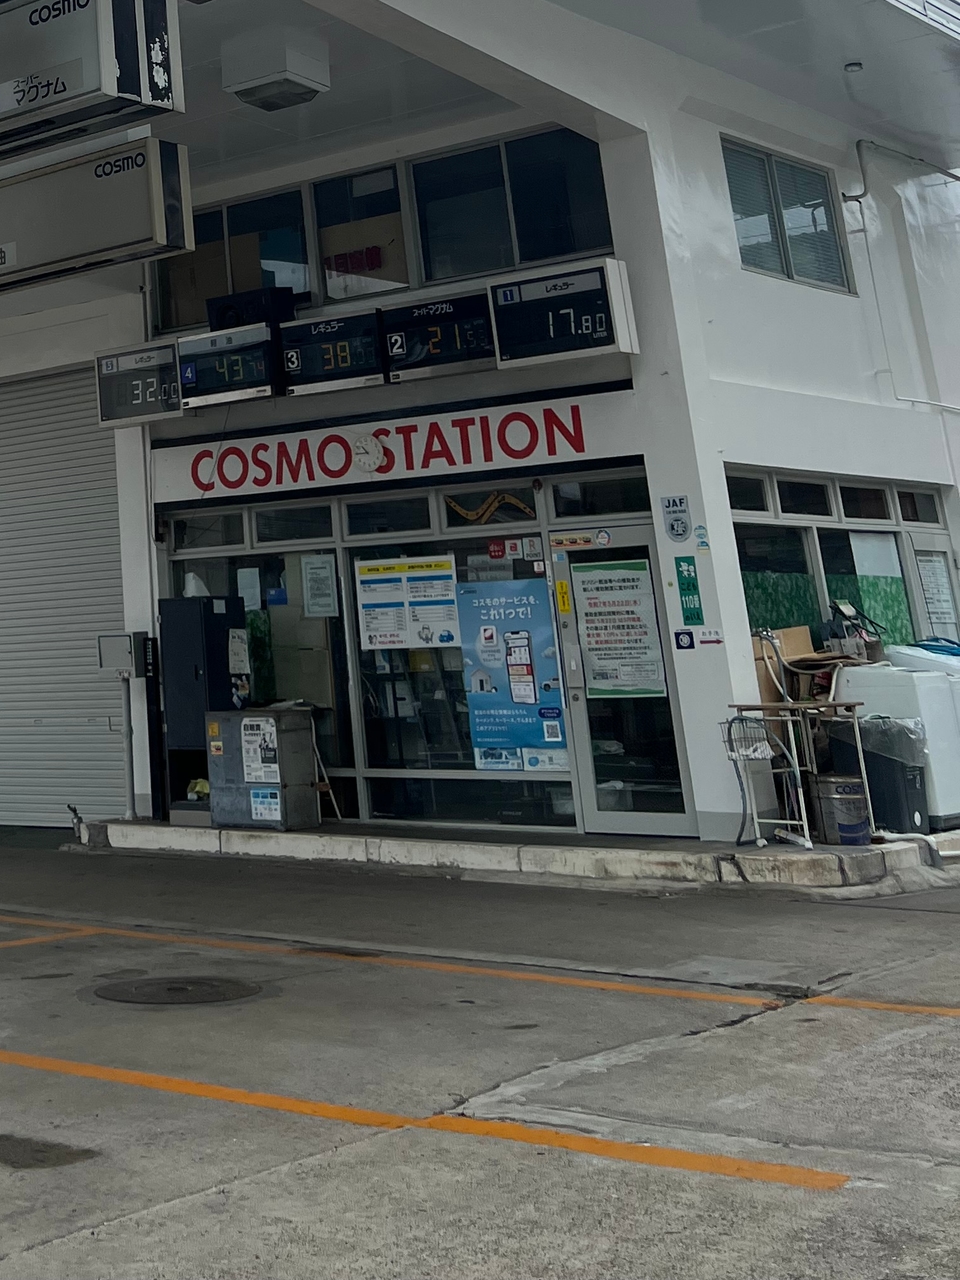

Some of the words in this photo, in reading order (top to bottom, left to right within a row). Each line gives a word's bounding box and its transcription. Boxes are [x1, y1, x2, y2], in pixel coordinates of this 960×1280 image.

[13, 77, 67, 106] マグナム
[94, 152, 146, 178] COSMO
[545, 282, 575, 293] レギュラー
[311, 321, 344, 334] レギュラー
[391, 336, 402, 353] 2
[287, 352, 298, 368] 3
[185, 369, 193, 380] 4
[190, 434, 352, 492] COSMO
[371, 404, 586, 474] STATION
[664, 498, 685, 509] JAF
